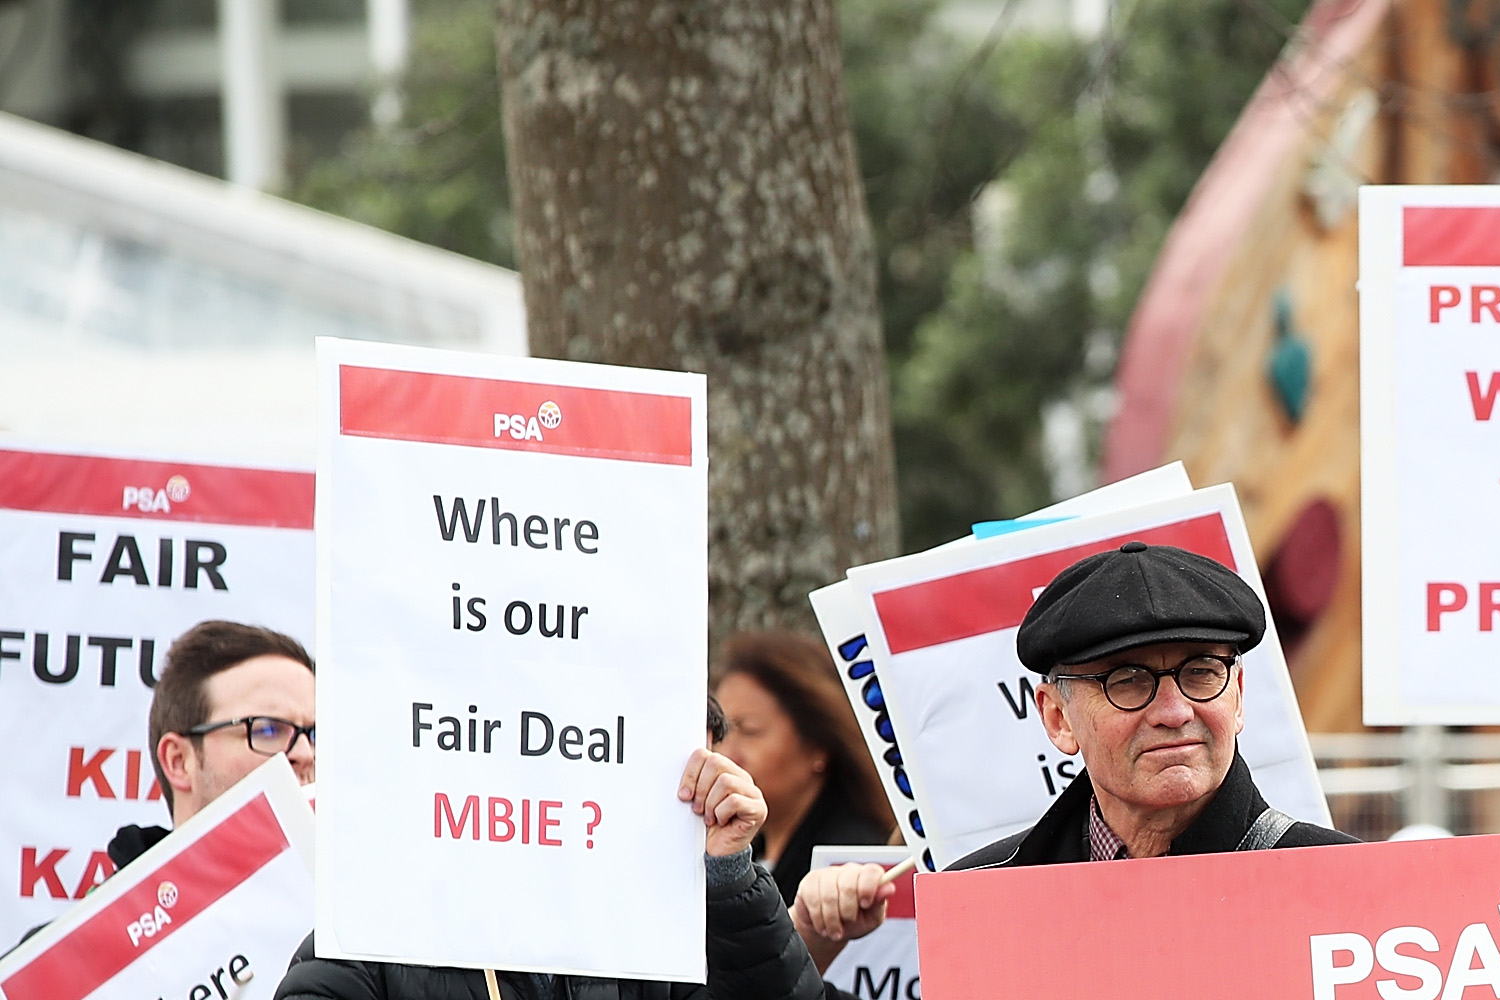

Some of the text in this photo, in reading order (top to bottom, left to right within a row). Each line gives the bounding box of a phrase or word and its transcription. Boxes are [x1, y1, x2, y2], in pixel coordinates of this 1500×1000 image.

[494, 412, 542, 441] PSA
[123, 486, 170, 513] PSA
[434, 495, 600, 555] Where
[56, 531, 229, 592] FAIR
[451, 583, 589, 641] is our
[411, 703, 625, 764] Fair Deal
[434, 792, 562, 847] MBIE
[127, 907, 172, 947] PSA
